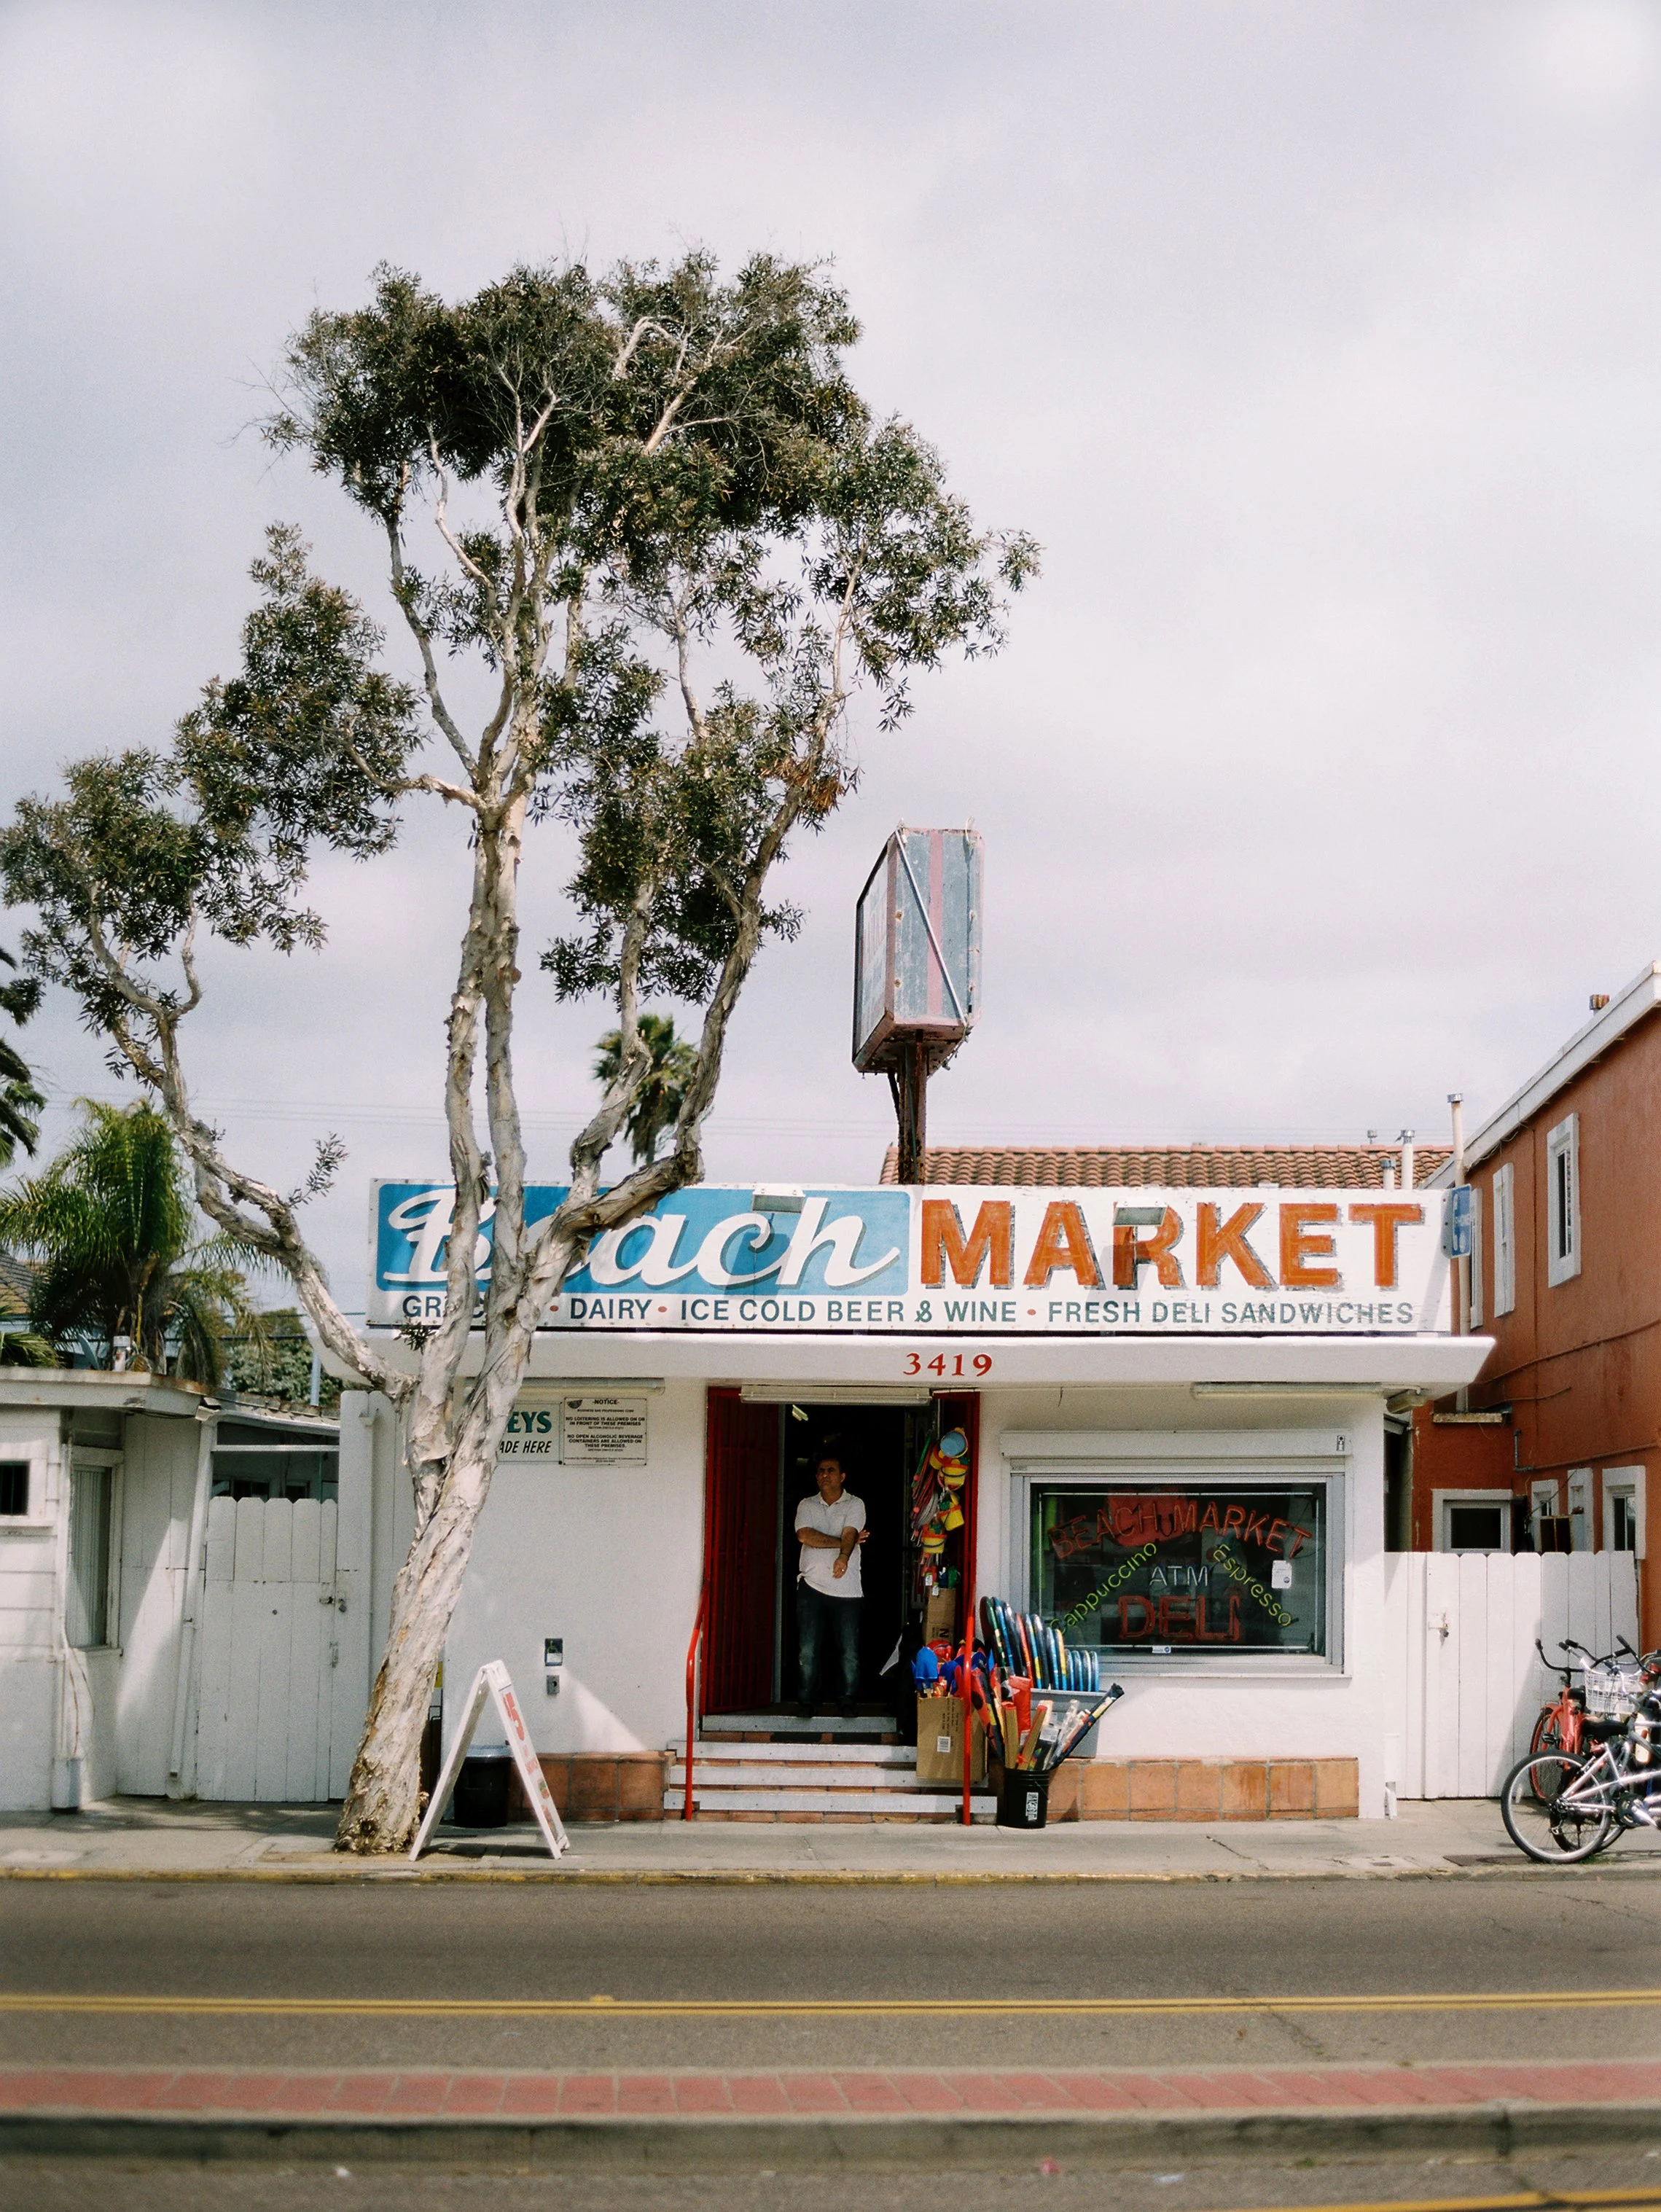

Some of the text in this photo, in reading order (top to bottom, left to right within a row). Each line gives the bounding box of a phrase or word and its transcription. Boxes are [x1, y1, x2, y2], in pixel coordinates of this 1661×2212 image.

[920, 1199, 1426, 1291] MARKET
[570, 1298, 1413, 1324] DAIRY ICE COLD BEER & WINE FRESH DELI SANDWICHES
[903, 1352, 993, 1377] 3419
[507, 1411, 552, 1434] EYS
[499, 1440, 552, 1453] ADE HERE
[1047, 1501, 1313, 1560] BEACH MARKET
[1049, 1541, 1157, 1635] Cappuccino
[1149, 1566, 1208, 1587] ATM
[1213, 1543, 1293, 1627] Espresso
[1117, 1595, 1241, 1641] DELI
